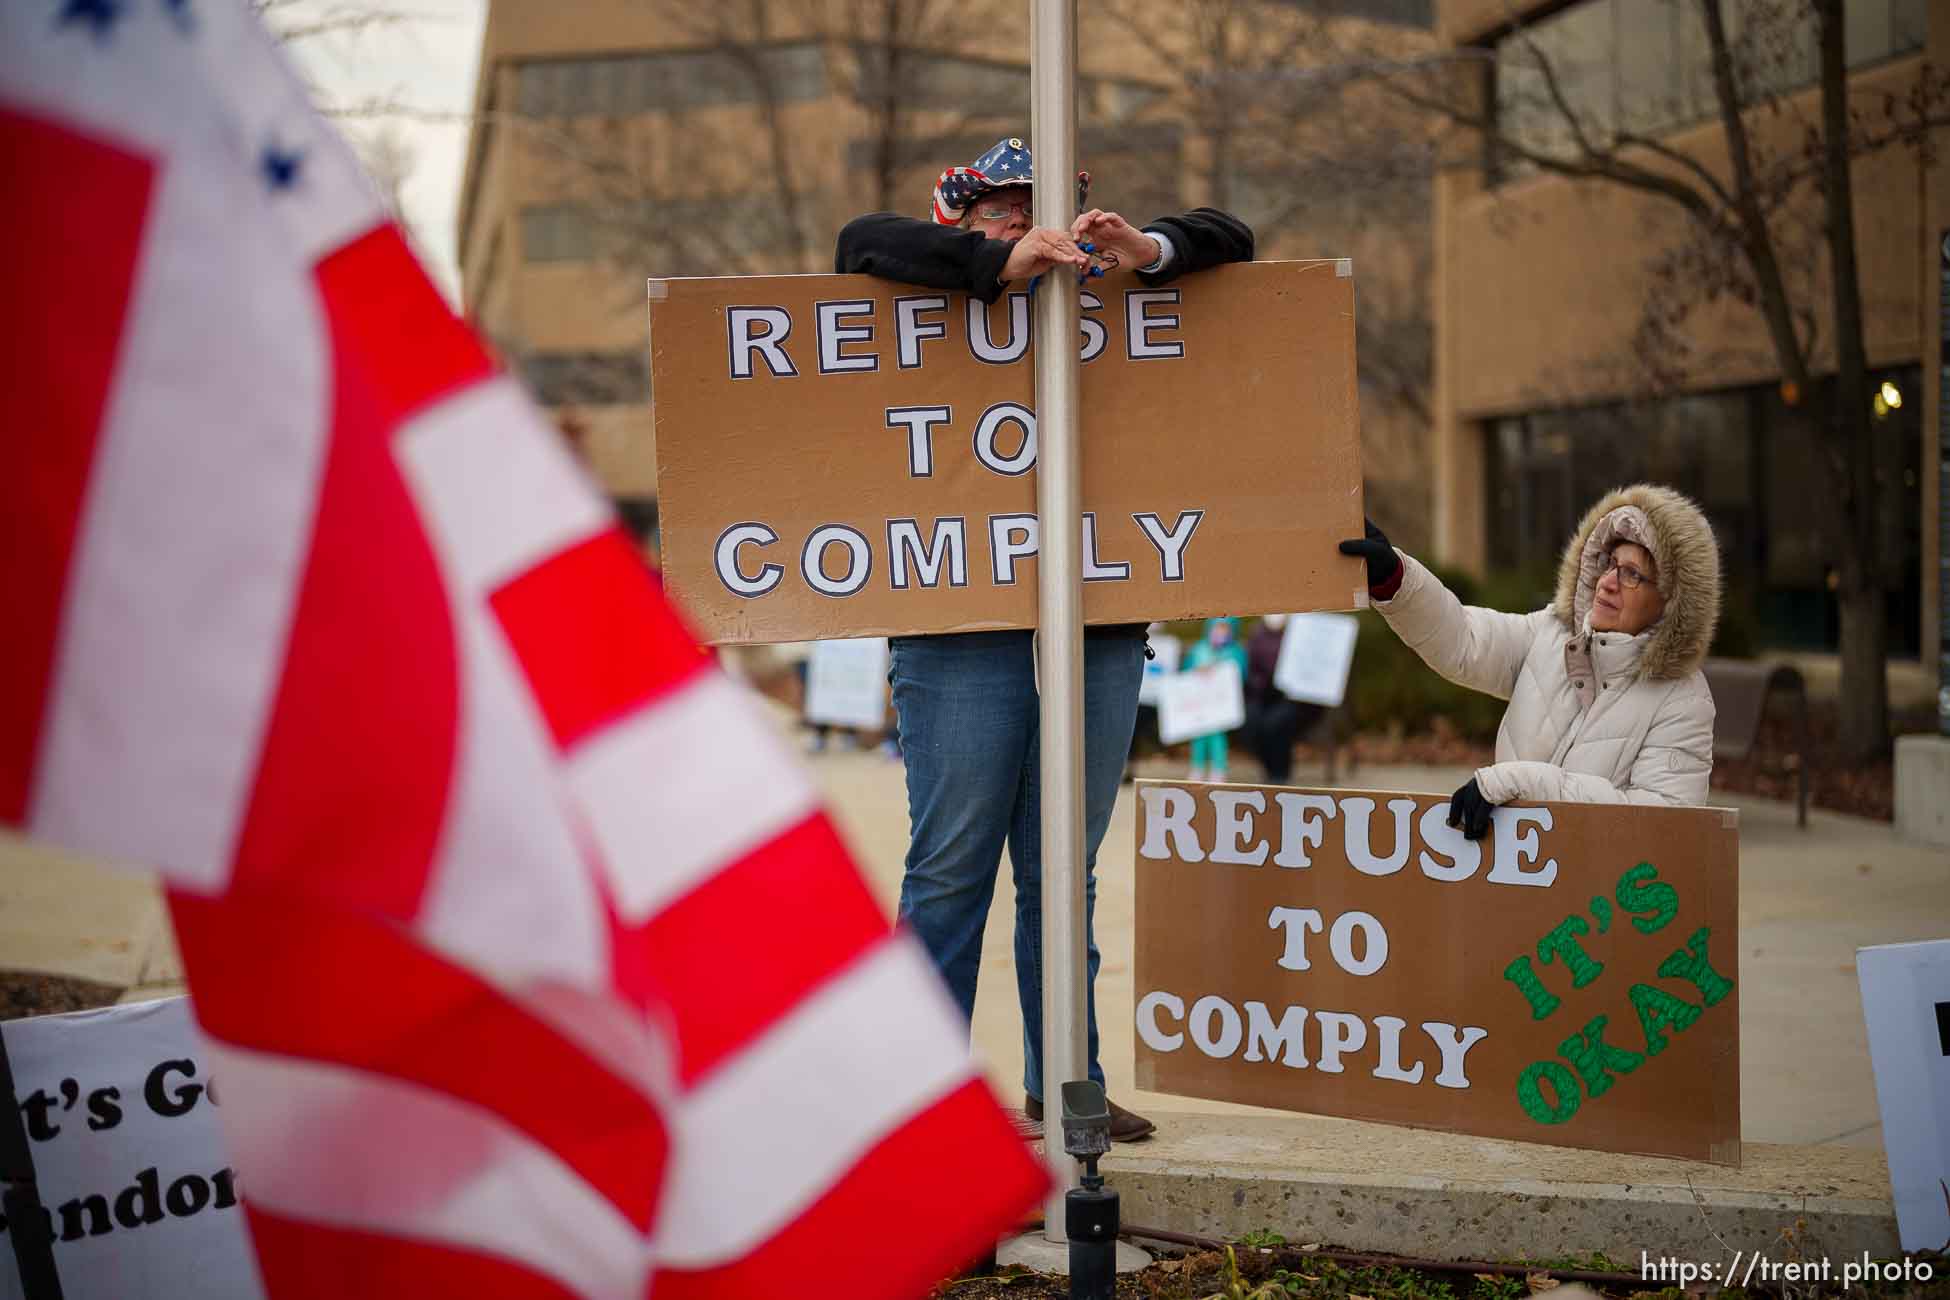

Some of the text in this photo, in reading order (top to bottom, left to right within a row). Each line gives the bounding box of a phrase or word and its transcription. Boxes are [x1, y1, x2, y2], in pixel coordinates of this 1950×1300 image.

[885, 402, 1038, 478] TO
[713, 509, 1205, 599] COMPLY
[1138, 786, 1558, 888] REFUSE
[1268, 906, 1390, 976] TO
[1134, 990, 1488, 1089] COMPLY
[1517, 927, 1735, 1125] OKAY
[144, 1058, 222, 1118] G
[40, 1166, 240, 1243] ndo
